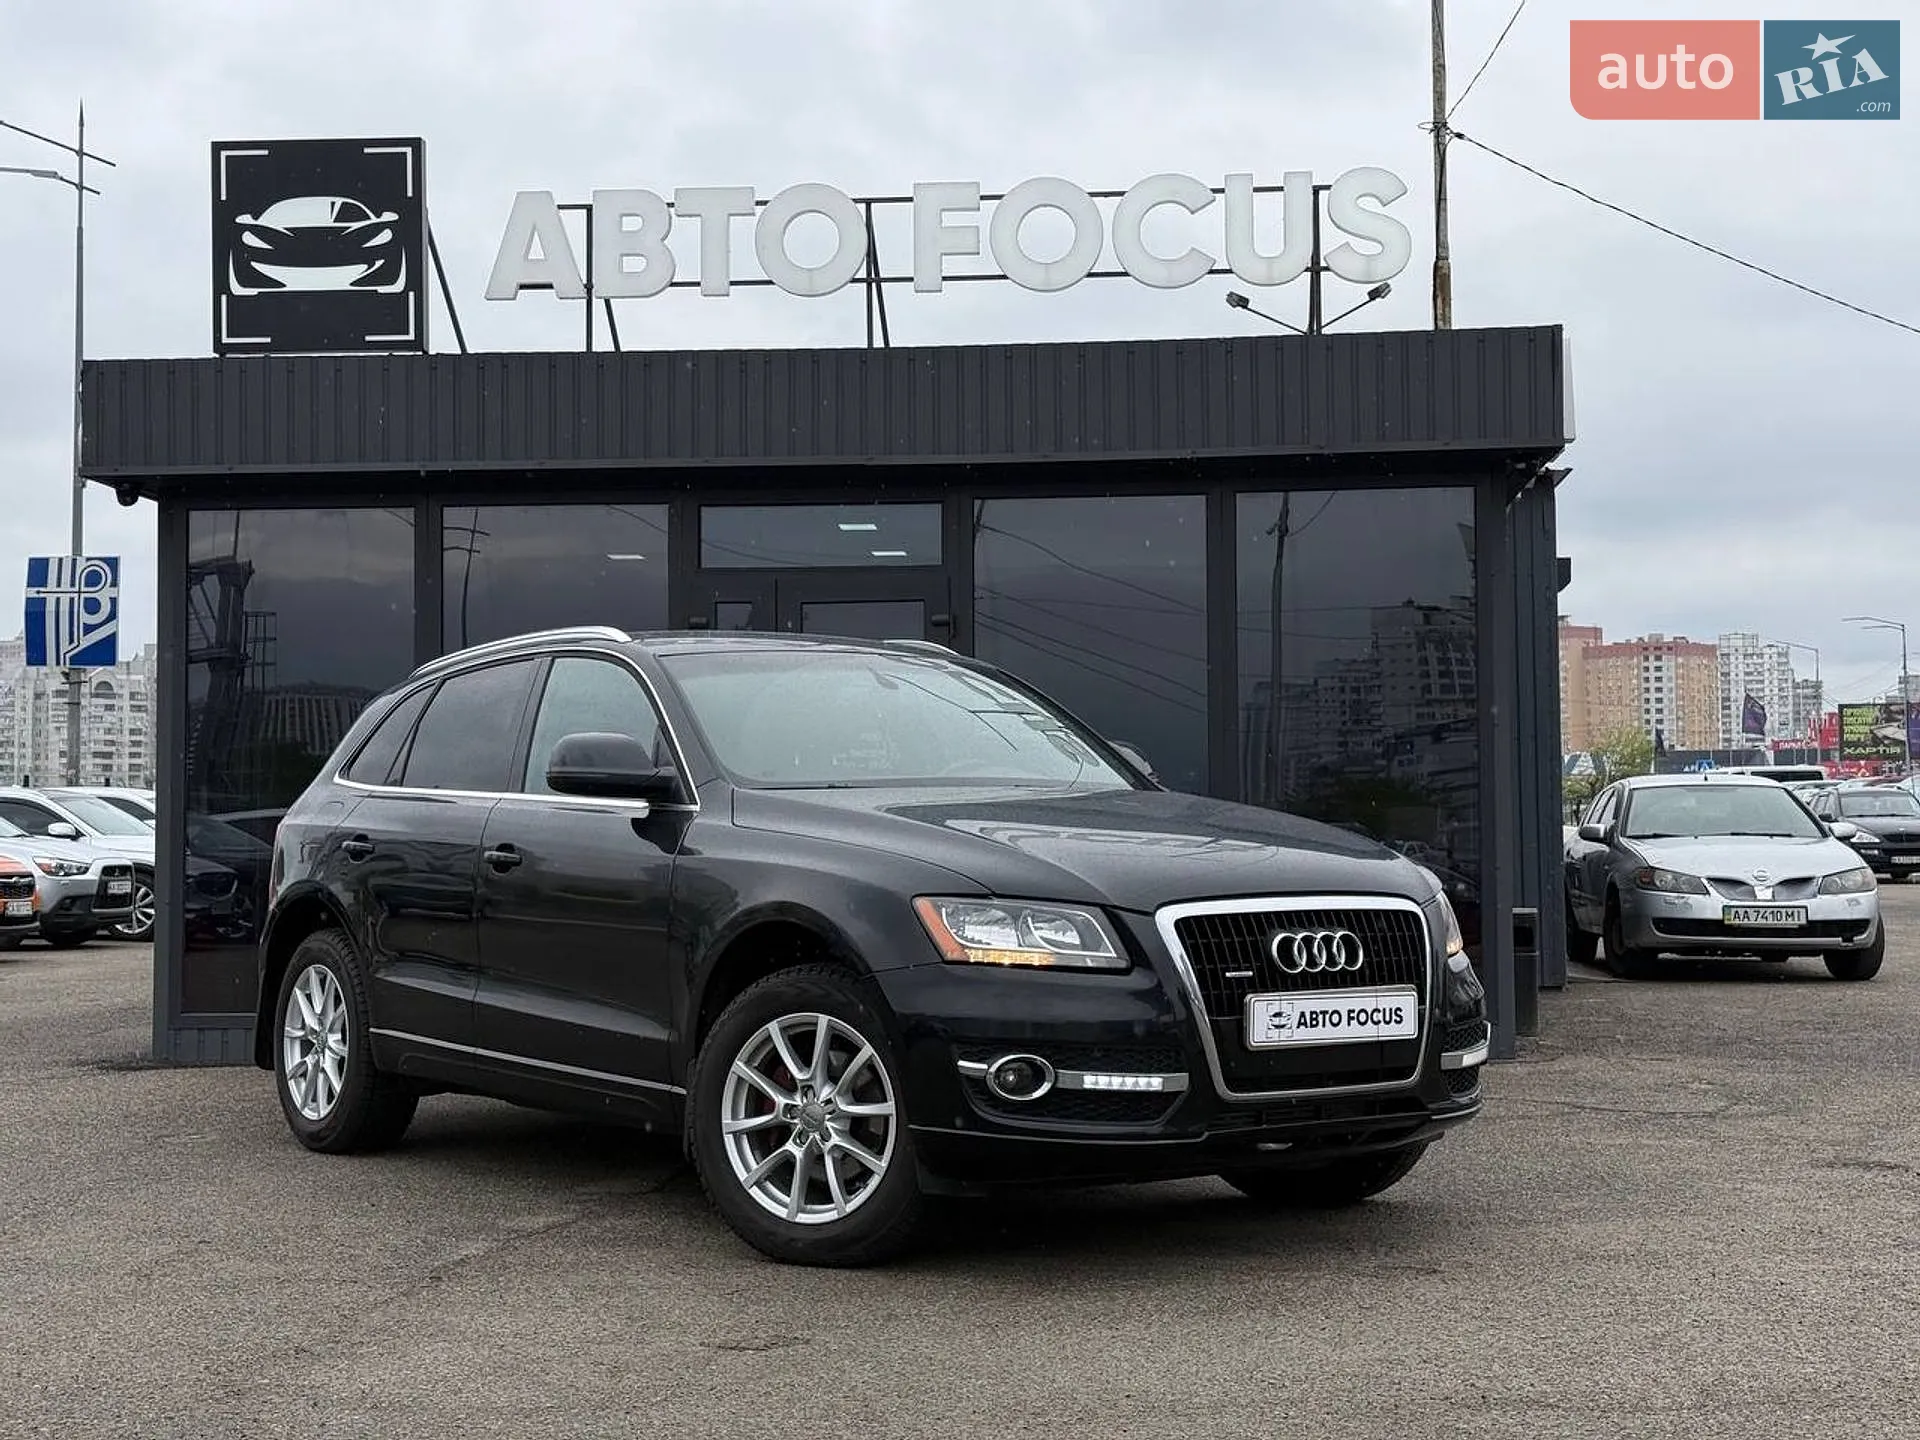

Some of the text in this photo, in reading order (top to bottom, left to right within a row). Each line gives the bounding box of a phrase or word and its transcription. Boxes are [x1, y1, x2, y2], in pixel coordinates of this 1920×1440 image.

[485, 167, 1412, 300] АВТО FOCUS
[1296, 1006, 1403, 1029] АВТО FOCUS
